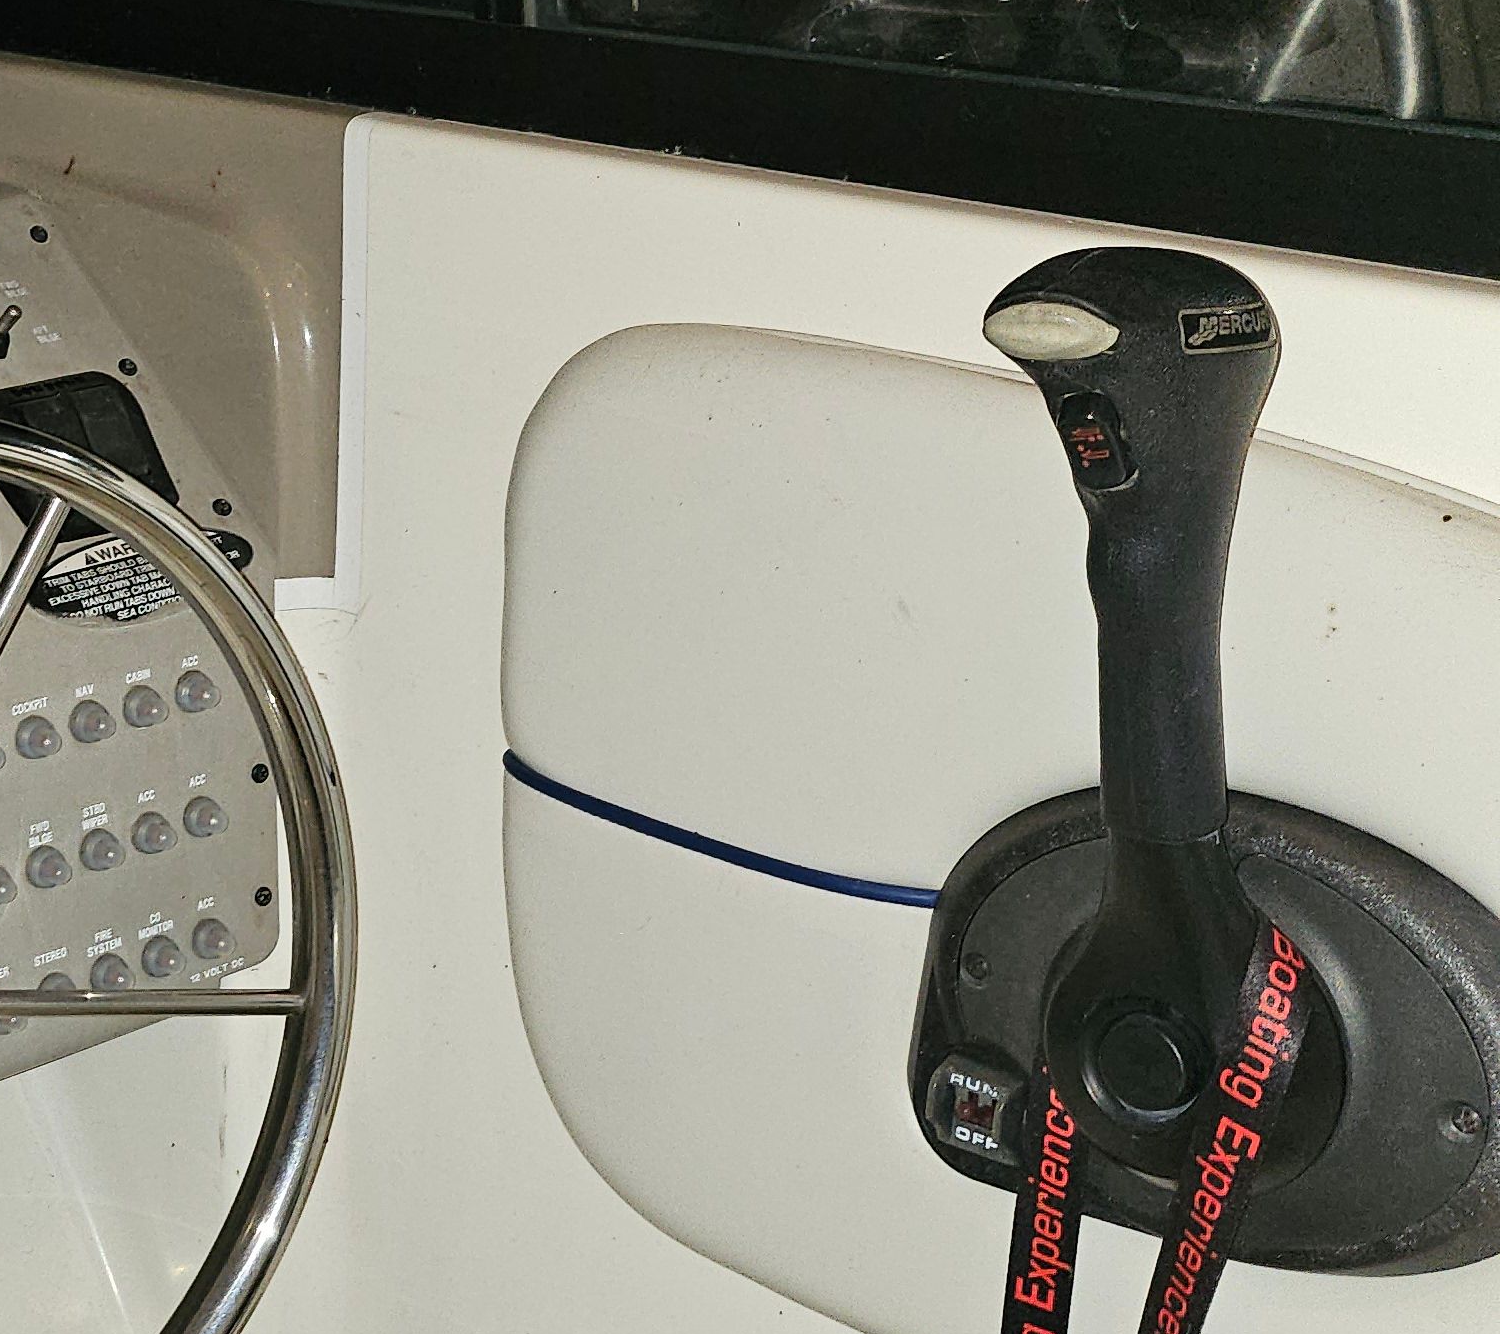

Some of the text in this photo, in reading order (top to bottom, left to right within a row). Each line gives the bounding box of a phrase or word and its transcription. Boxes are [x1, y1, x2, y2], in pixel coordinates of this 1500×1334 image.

[45, 560, 137, 588] TRIM TABS SHOULD
[60, 570, 132, 594] TO STARBOARD
[49, 575, 150, 607] EXCESSIVE DOWN TAB
[81, 578, 172, 609] HANDLING CHARAC
[85, 605, 104, 617] NOT
[104, 601, 124, 613] RUN
[123, 596, 148, 609] TABS
[148, 589, 178, 605] DOWN
[117, 608, 138, 621] SEA
[181, 654, 199, 668] ACC
[125, 668, 151, 684] CABIN
[74, 683, 94, 698] NAV
[11, 696, 49, 716] COCKPIT
[188, 773, 207, 788] ACC
[137, 789, 156, 804] ACC
[82, 802, 106, 818] STBD
[29, 820, 50, 835] FWD
[81, 814, 109, 831] WIPER
[28, 831, 54, 848] BILGE
[198, 896, 215, 912] ACC
[150, 911, 161, 924] CO
[94, 927, 113, 943] FIRE
[138, 919, 174, 940] MONITOR
[87, 936, 123, 958] SYSTEM
[33, 946, 68, 967] STEREO
[189, 956, 246, 984] 12 VOLT DC
[1220, 926, 1306, 1109] Boating
[950, 1071, 999, 1099] RUN
[954, 1125, 999, 1150] OFF
